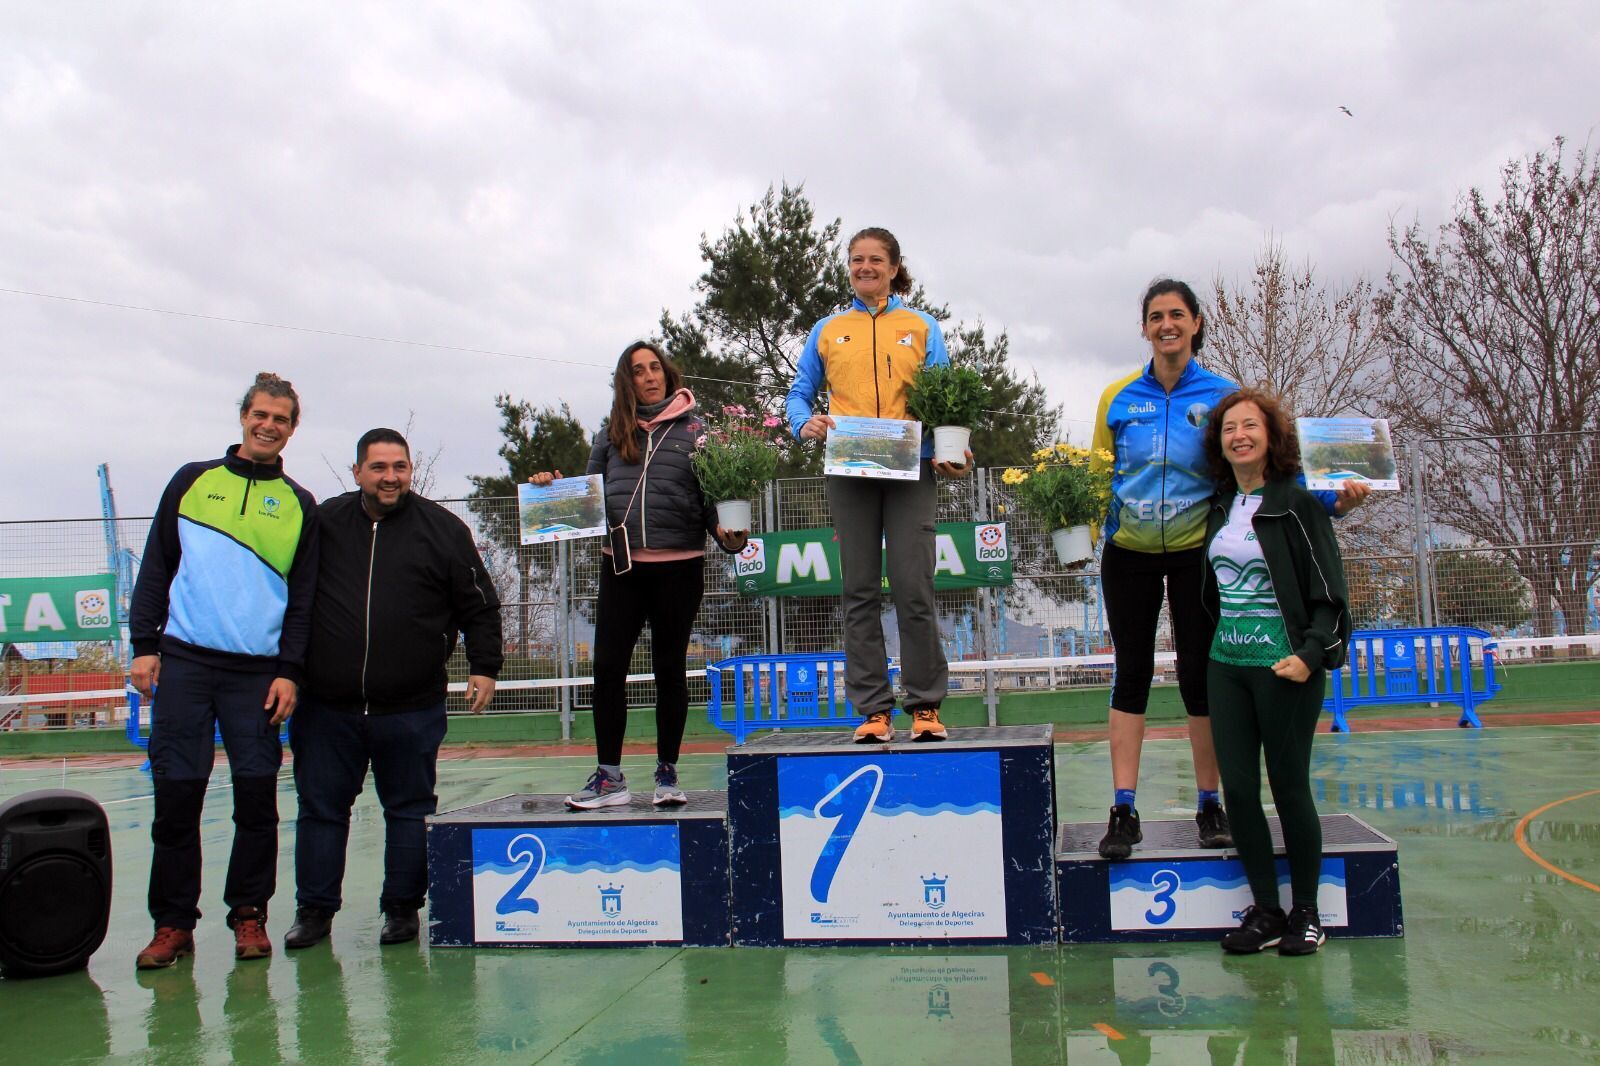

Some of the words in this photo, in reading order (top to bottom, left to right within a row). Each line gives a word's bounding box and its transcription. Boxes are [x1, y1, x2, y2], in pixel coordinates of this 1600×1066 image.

[1122, 498, 1178, 521] CEO
[980, 547, 1005, 559] fado
[738, 560, 763, 574] fado
[81, 614, 109, 626] fado
[811, 764, 884, 904] 1
[495, 833, 547, 916] 2
[1145, 869, 1181, 925] 3
[888, 911, 939, 920] Ayuntamiento
[951, 910, 985, 919] Algeciras
[567, 919, 616, 928] Ayuntamiento
[626, 918, 659, 927] Algeciras
[899, 920, 935, 928] Delegación
[578, 928, 611, 936] Delegación
